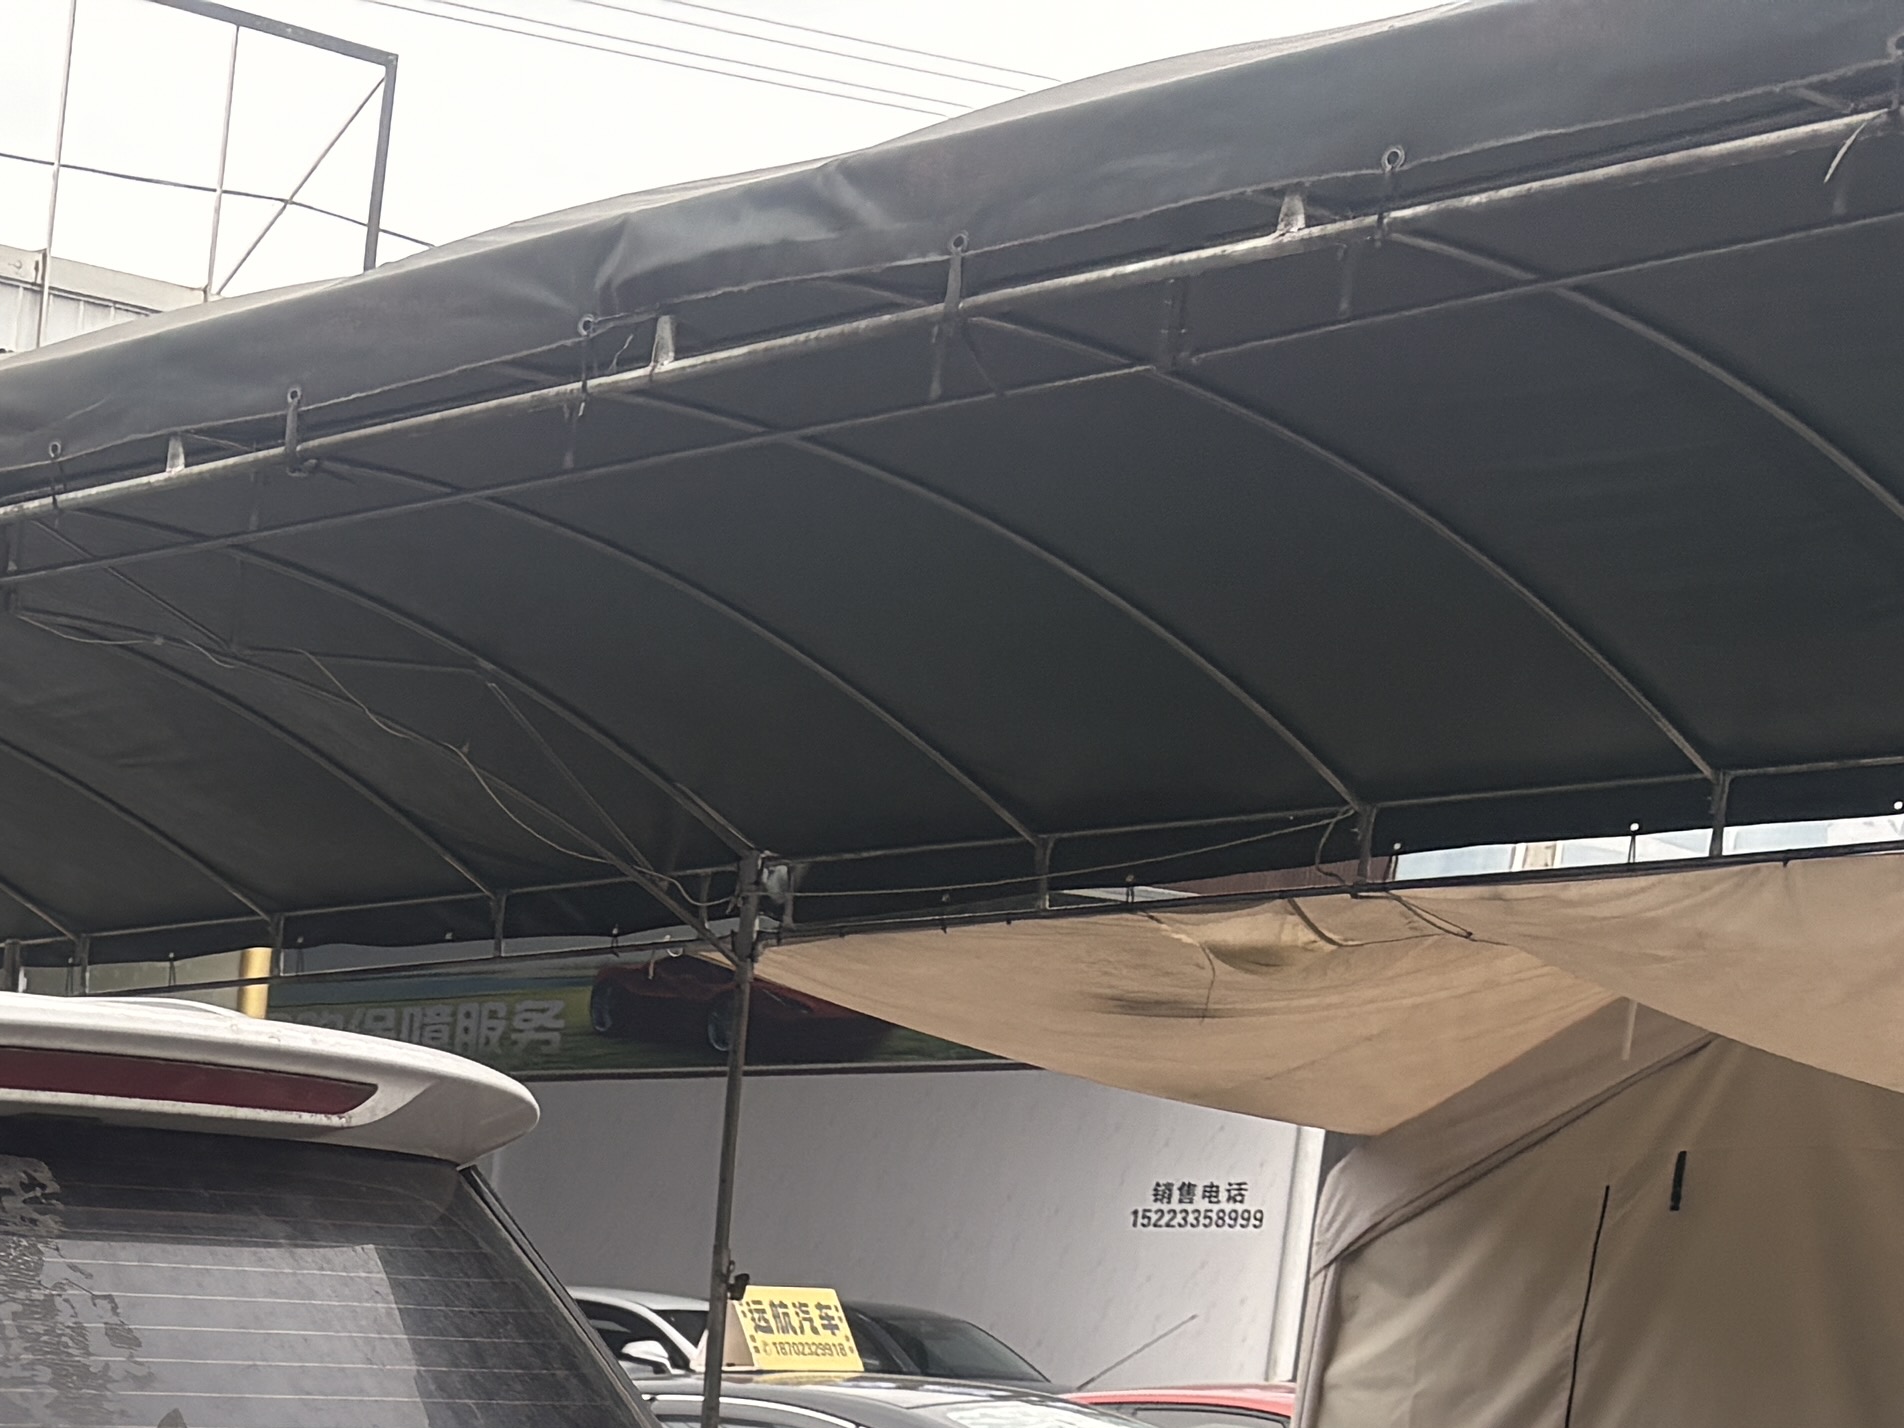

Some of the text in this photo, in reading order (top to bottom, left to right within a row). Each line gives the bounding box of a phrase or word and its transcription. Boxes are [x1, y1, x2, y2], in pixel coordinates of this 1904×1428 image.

[1152, 1181, 1249, 1205] 销售电话
[1131, 1208, 1264, 1230] 15223358999
[747, 1299, 841, 1337] 运航汽车
